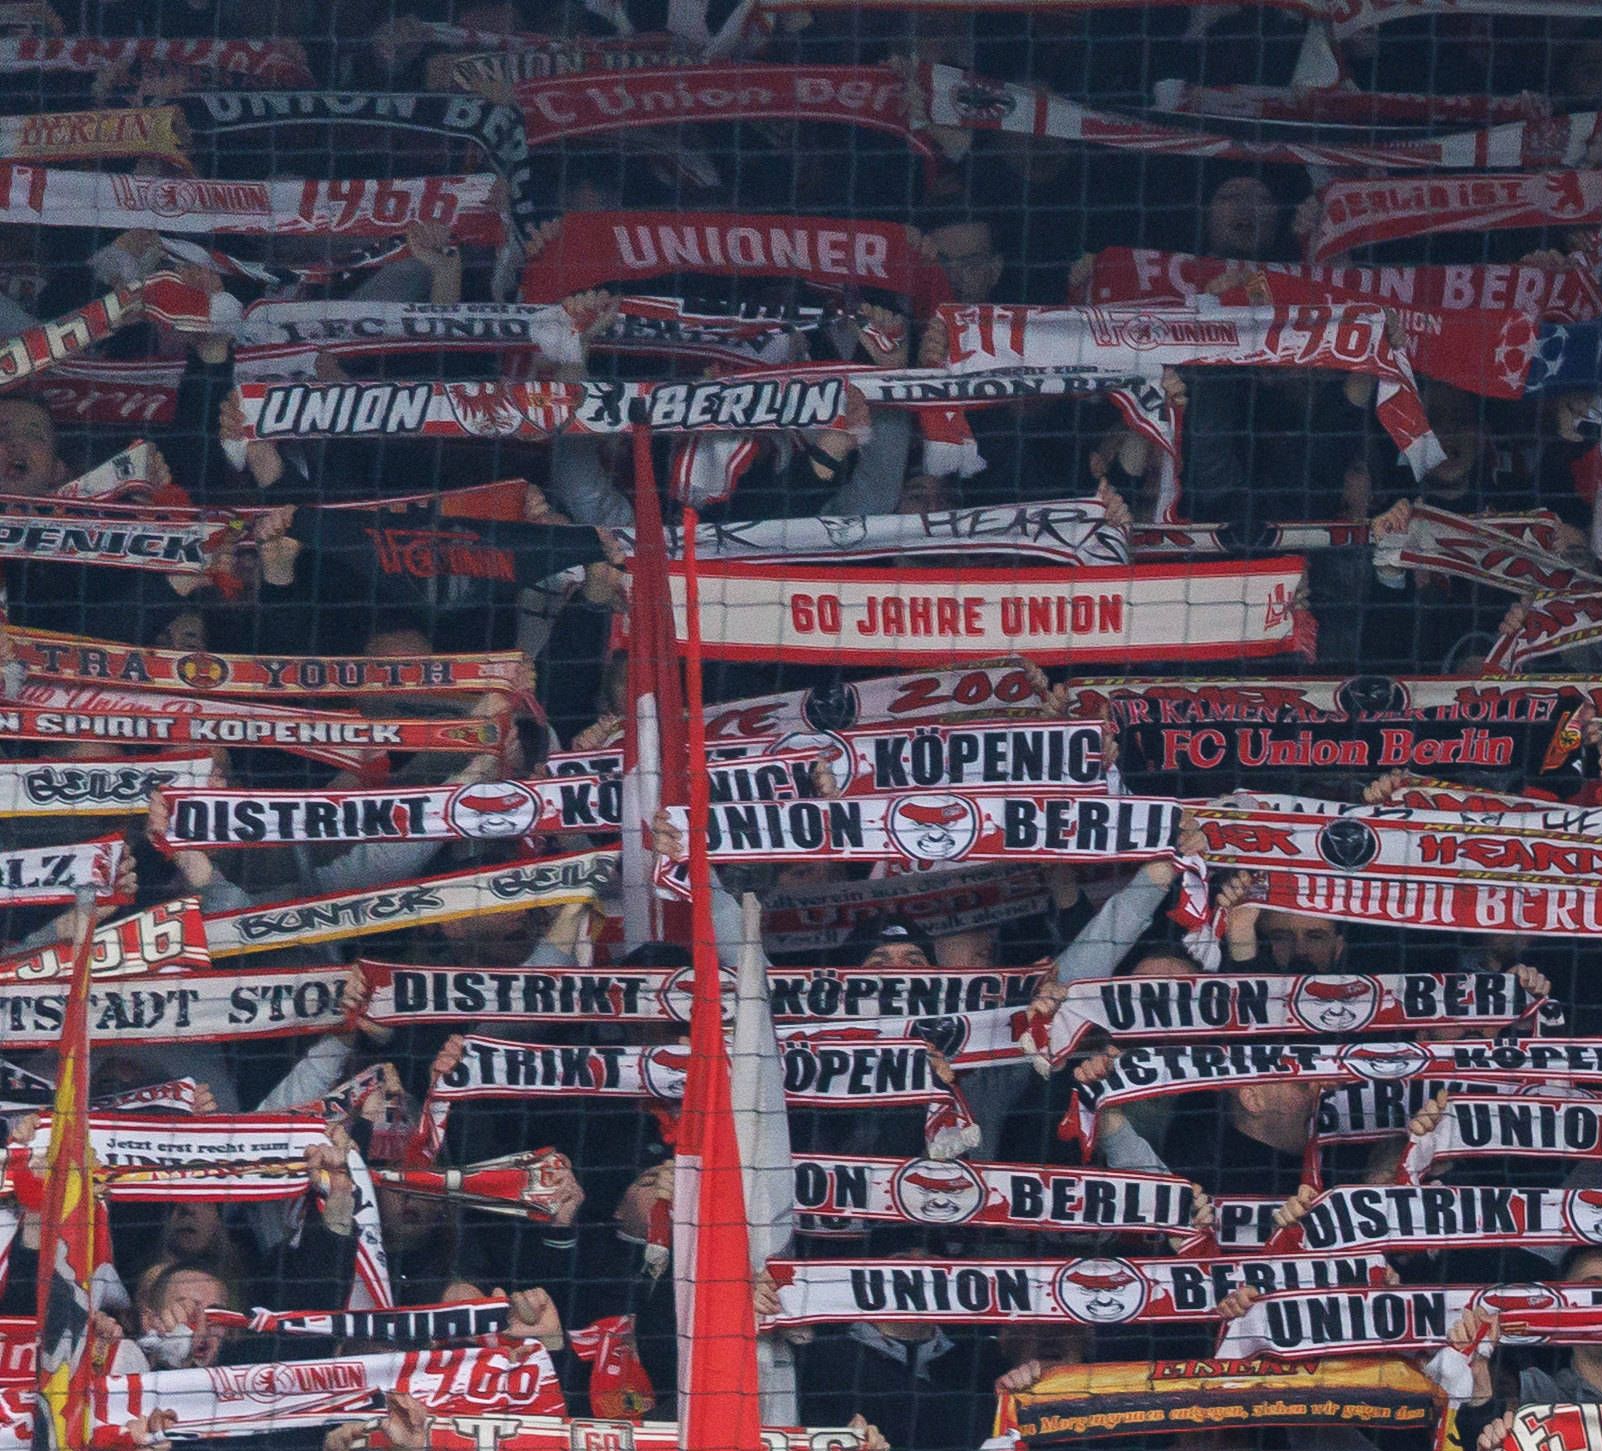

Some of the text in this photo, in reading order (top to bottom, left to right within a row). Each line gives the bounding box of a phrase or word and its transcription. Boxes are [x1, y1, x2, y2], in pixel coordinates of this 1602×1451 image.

[610, 222, 890, 280] UNIONER
[256, 372, 844, 435] UNION BERLIN
[790, 593, 1124, 639] 60 JAHRE UNION
[261, 656, 455, 691] YOUTH
[36, 715, 174, 741] SPIRIT
[1160, 728, 1514, 771] FC Union Berlin
[175, 794, 432, 845] DISTRIKT
[392, 968, 649, 1015] DISTRIKT
[1100, 980, 1272, 1031] UNION
[105, 1135, 146, 1152] Jetzt
[151, 1136, 191, 1152] erst
[196, 1139, 242, 1154] recht
[1304, 1186, 1552, 1249] DISTRIKT
[849, 1268, 1034, 1312] UNION
[1269, 1290, 1447, 1346] UNION
[299, 1360, 366, 1392] UNION
